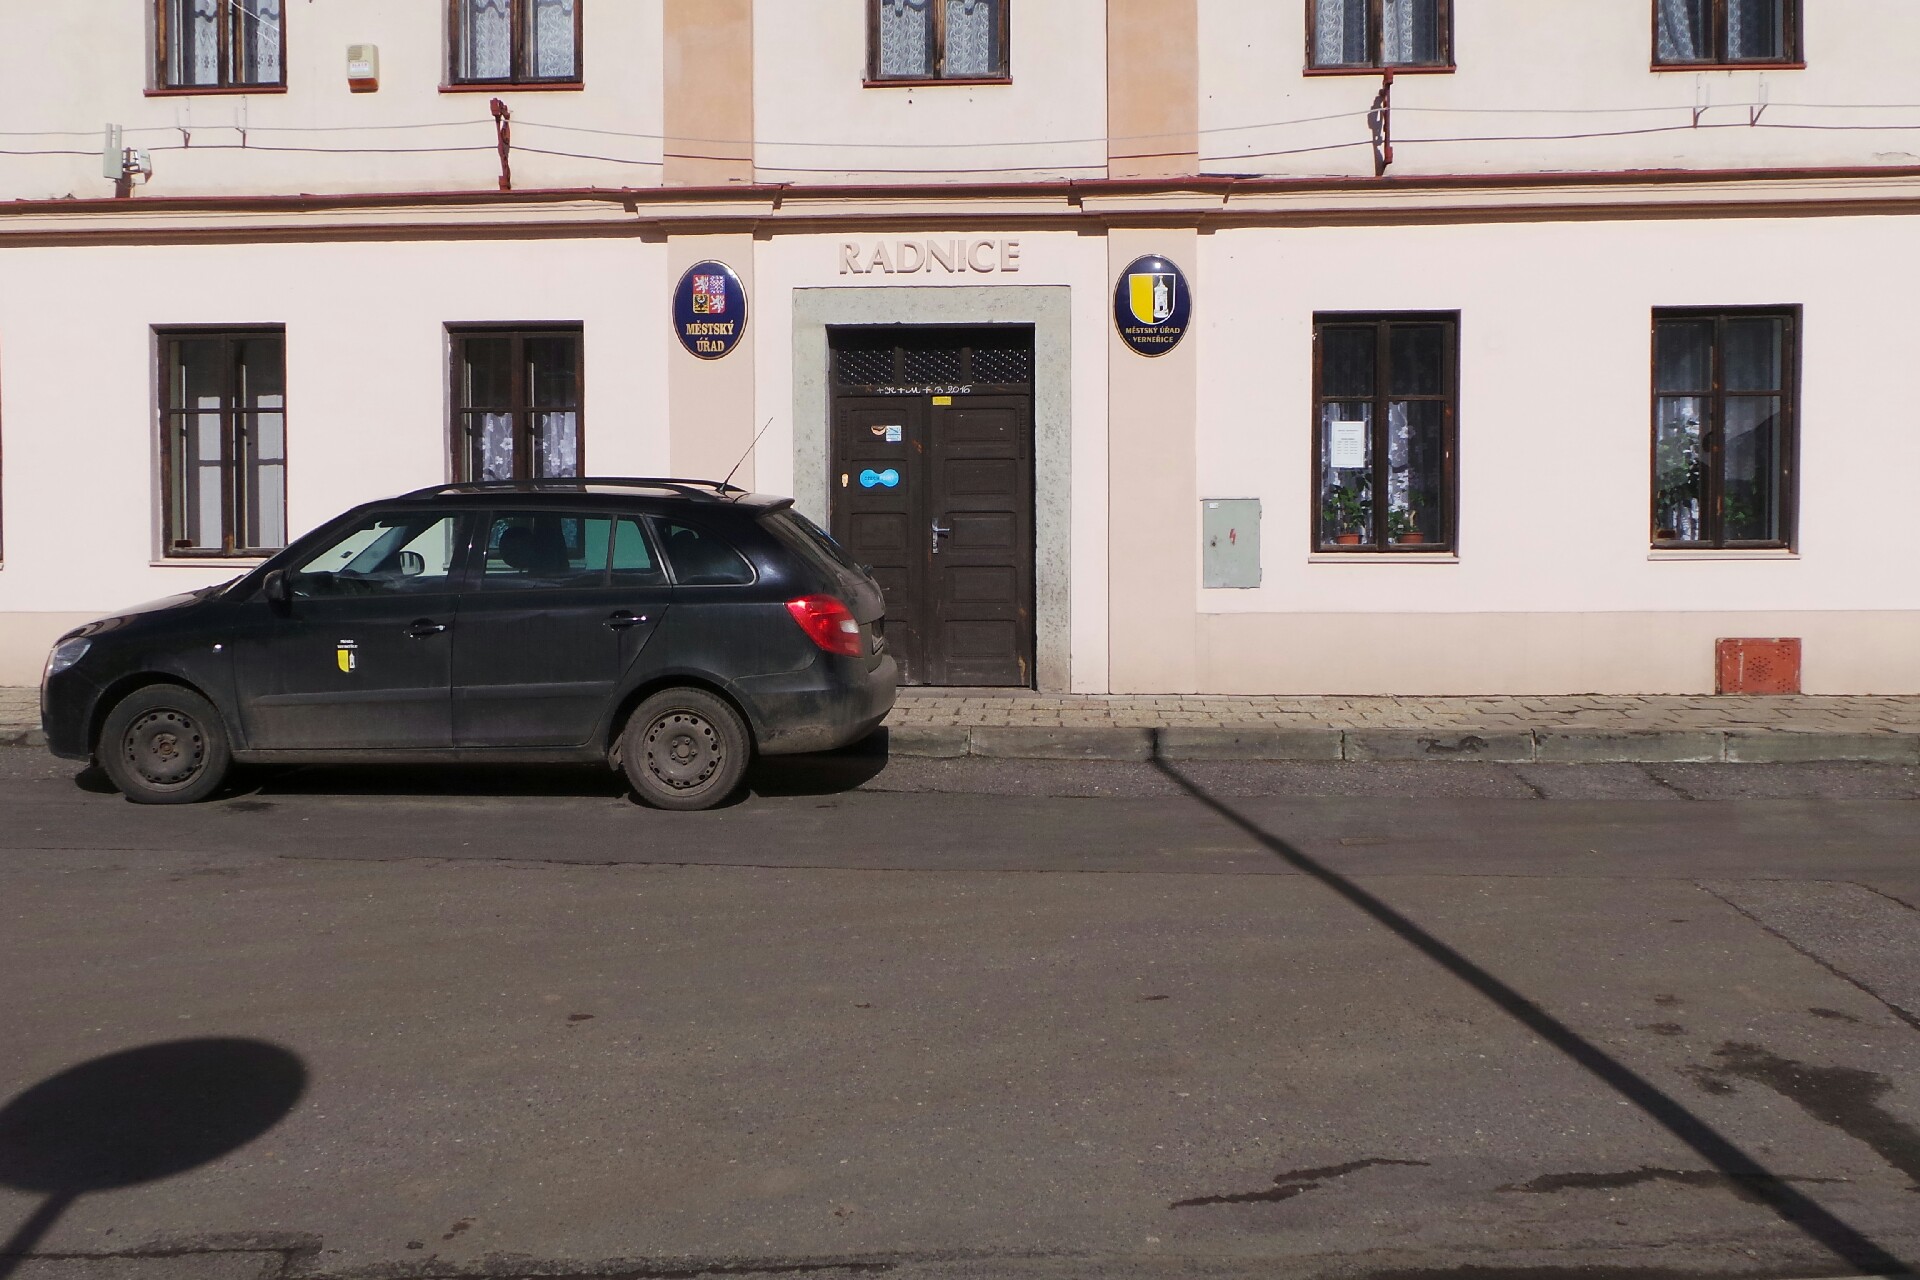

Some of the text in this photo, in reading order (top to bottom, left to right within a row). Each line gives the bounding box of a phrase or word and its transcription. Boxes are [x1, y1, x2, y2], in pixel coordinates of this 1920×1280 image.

[839, 239, 1020, 275] RADNICE
[685, 319, 735, 335] MĚSTSKÝ
[1125, 326, 1180, 334] MĚSTSKÝ ÚŘAD
[696, 337, 725, 352] ÚŘAD
[1133, 335, 1173, 343] VERNEŘICE
[945, 384, 973, 394] 2016
